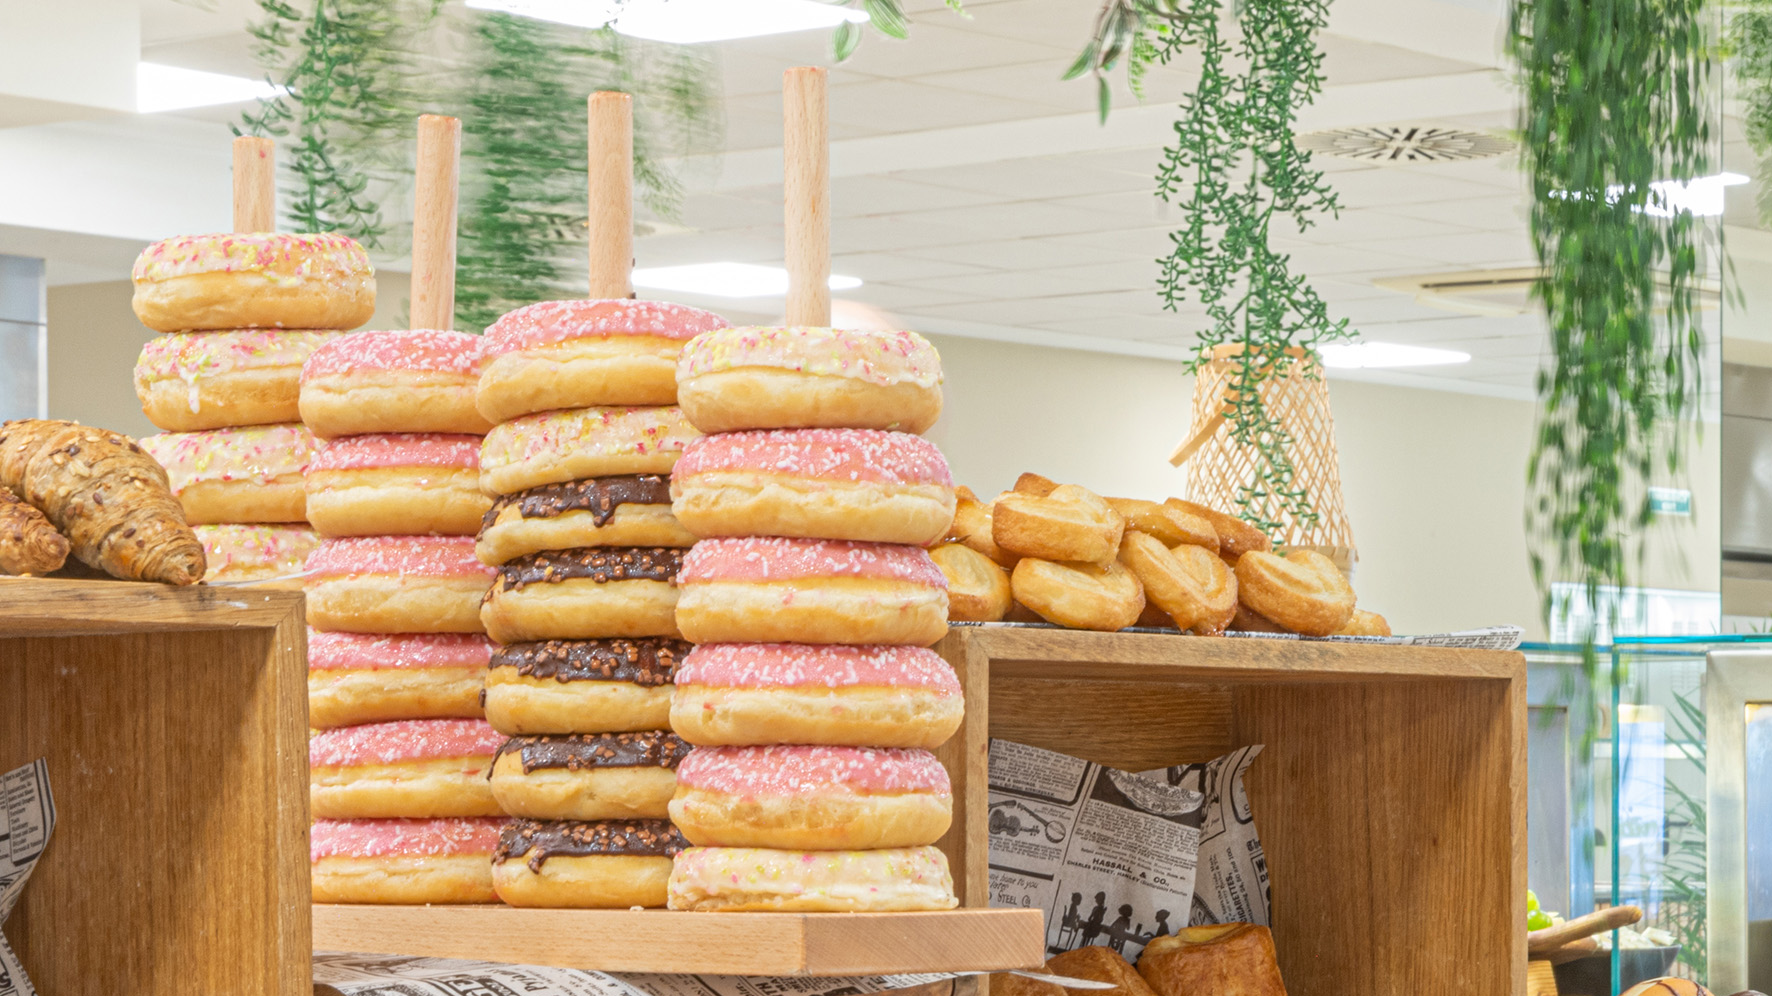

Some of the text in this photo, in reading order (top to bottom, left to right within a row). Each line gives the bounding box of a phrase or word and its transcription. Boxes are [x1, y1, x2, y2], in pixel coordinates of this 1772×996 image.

[1066, 860, 1091, 870] CHARLES
[1117, 869, 1140, 882] HANLEY
[1092, 857, 1133, 874] HASSALL
[1139, 871, 1147, 879] &
[1000, 873, 1016, 884] home
[1024, 881, 1039, 890] you
